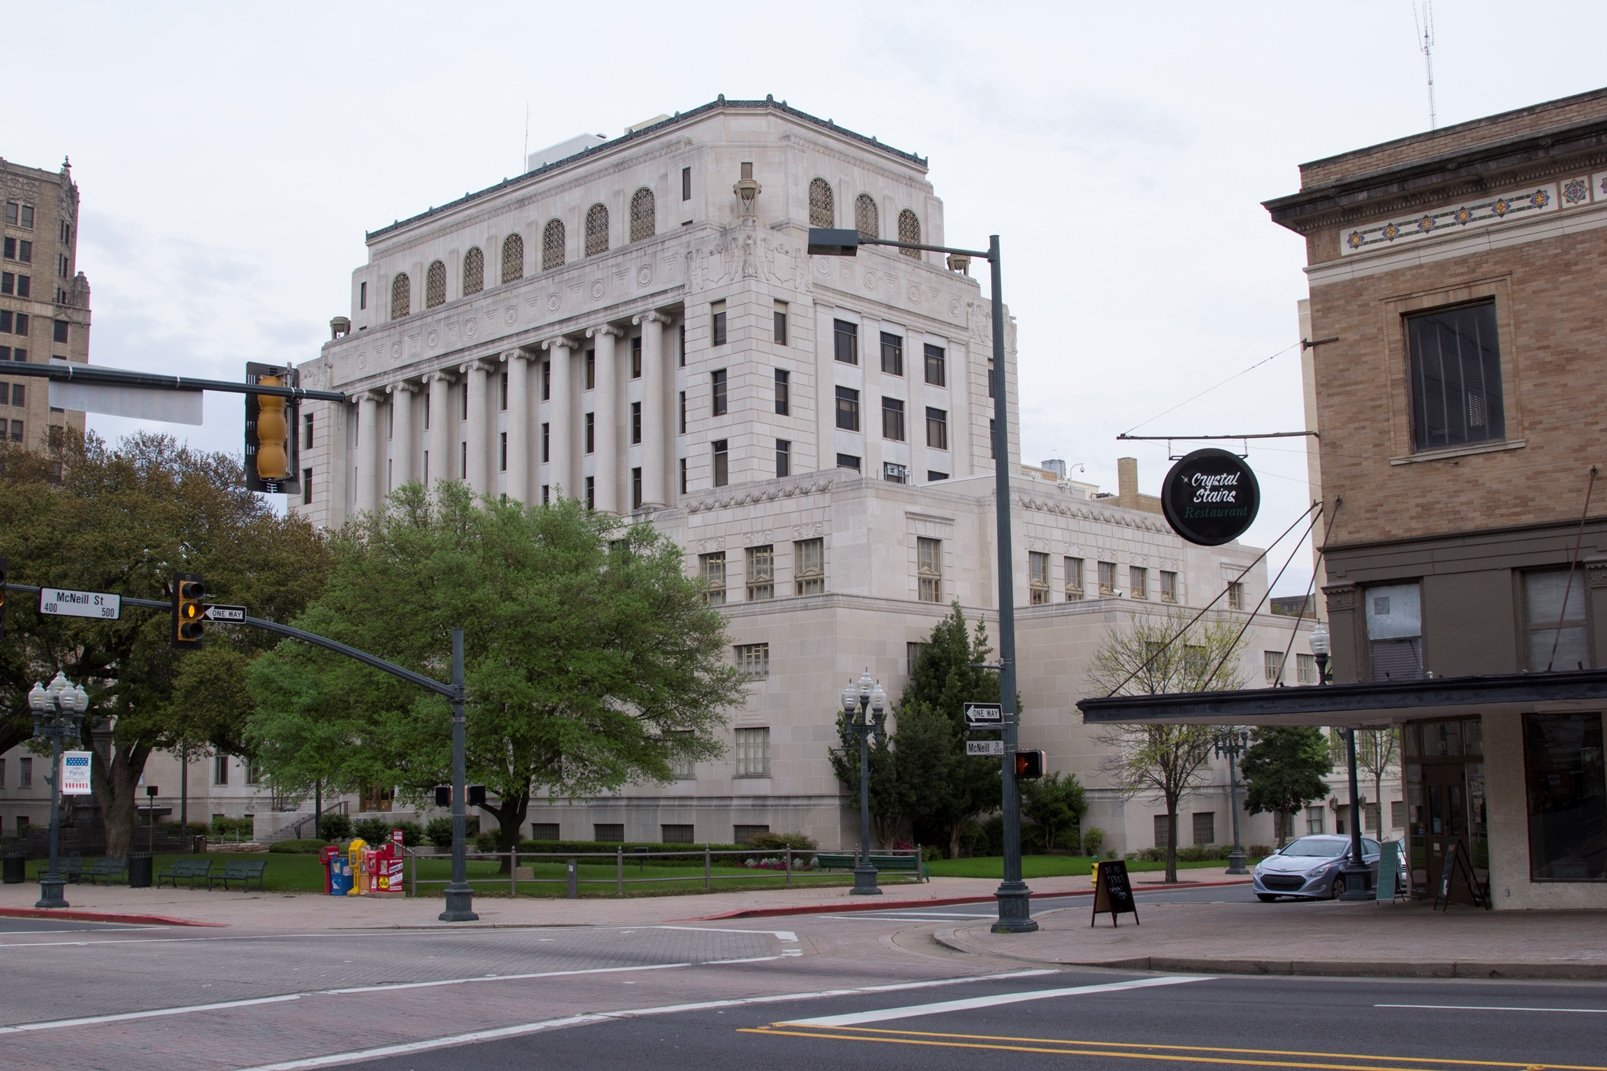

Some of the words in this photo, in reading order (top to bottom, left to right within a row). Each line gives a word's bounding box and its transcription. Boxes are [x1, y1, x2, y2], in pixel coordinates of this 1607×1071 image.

[1192, 472, 1240, 489] Crystal
[1193, 489, 1236, 502] Stairs
[1184, 506, 1247, 518] Restaurant
[57, 592, 89, 604] McNeill
[94, 595, 104, 605] St
[44, 603, 58, 612] 400
[101, 608, 115, 617] 500
[968, 743, 989, 752] McNeill
